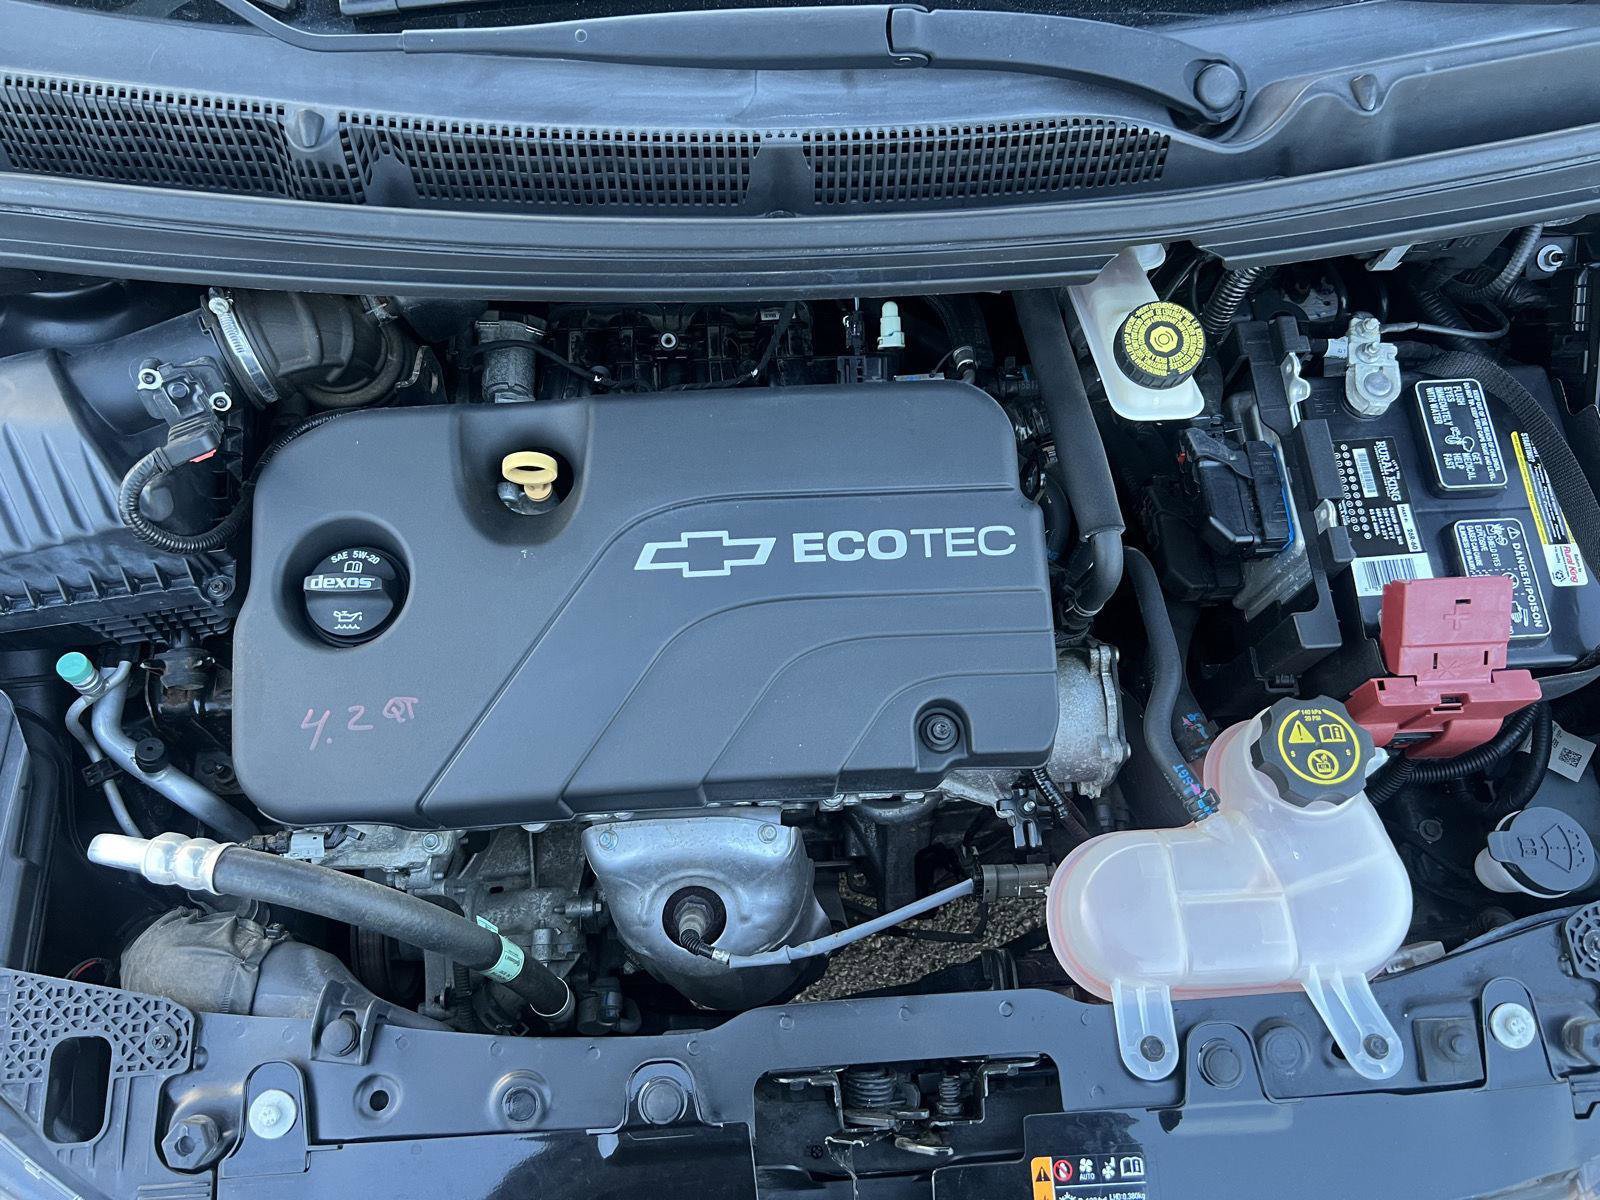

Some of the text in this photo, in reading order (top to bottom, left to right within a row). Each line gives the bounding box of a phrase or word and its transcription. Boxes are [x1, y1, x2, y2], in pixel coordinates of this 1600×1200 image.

[1444, 386, 1455, 402] EYES
[1453, 386, 1466, 406] FLUSH
[1426, 387, 1443, 424] WITH WATER
[1434, 387, 1453, 425] IMMEDIATELY
[1443, 453, 1456, 469] FAST
[1453, 453, 1465, 469] HELP
[1462, 453, 1476, 480] MEDICAL
[1472, 452, 1482, 465] GET
[1376, 441, 1401, 501] RURAL KING
[792, 525, 1016, 563] ECOTEC
[330, 550, 380, 565] SAE 5W-20
[1492, 553, 1501, 567] EYES
[1564, 546, 1575, 565] Rural
[310, 574, 375, 589] dexos
[1569, 566, 1578, 583] King
[1512, 542, 1543, 628] DANGER/POISON
[382, 697, 419, 722] QT
